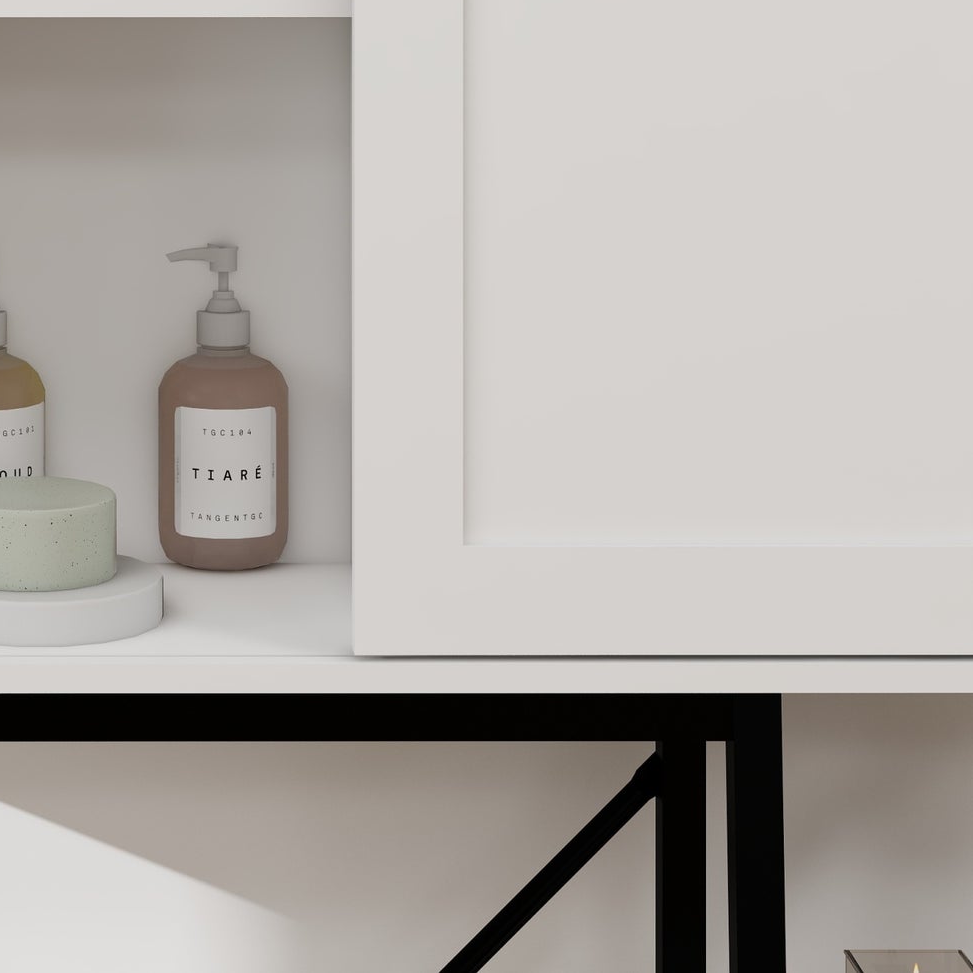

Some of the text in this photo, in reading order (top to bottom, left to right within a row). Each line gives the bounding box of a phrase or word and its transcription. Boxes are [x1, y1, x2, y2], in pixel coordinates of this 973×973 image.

[202, 428, 252, 437] TGC104
[192, 465, 262, 481] TIARÉ
[190, 512, 263, 522] TANGENTGC
